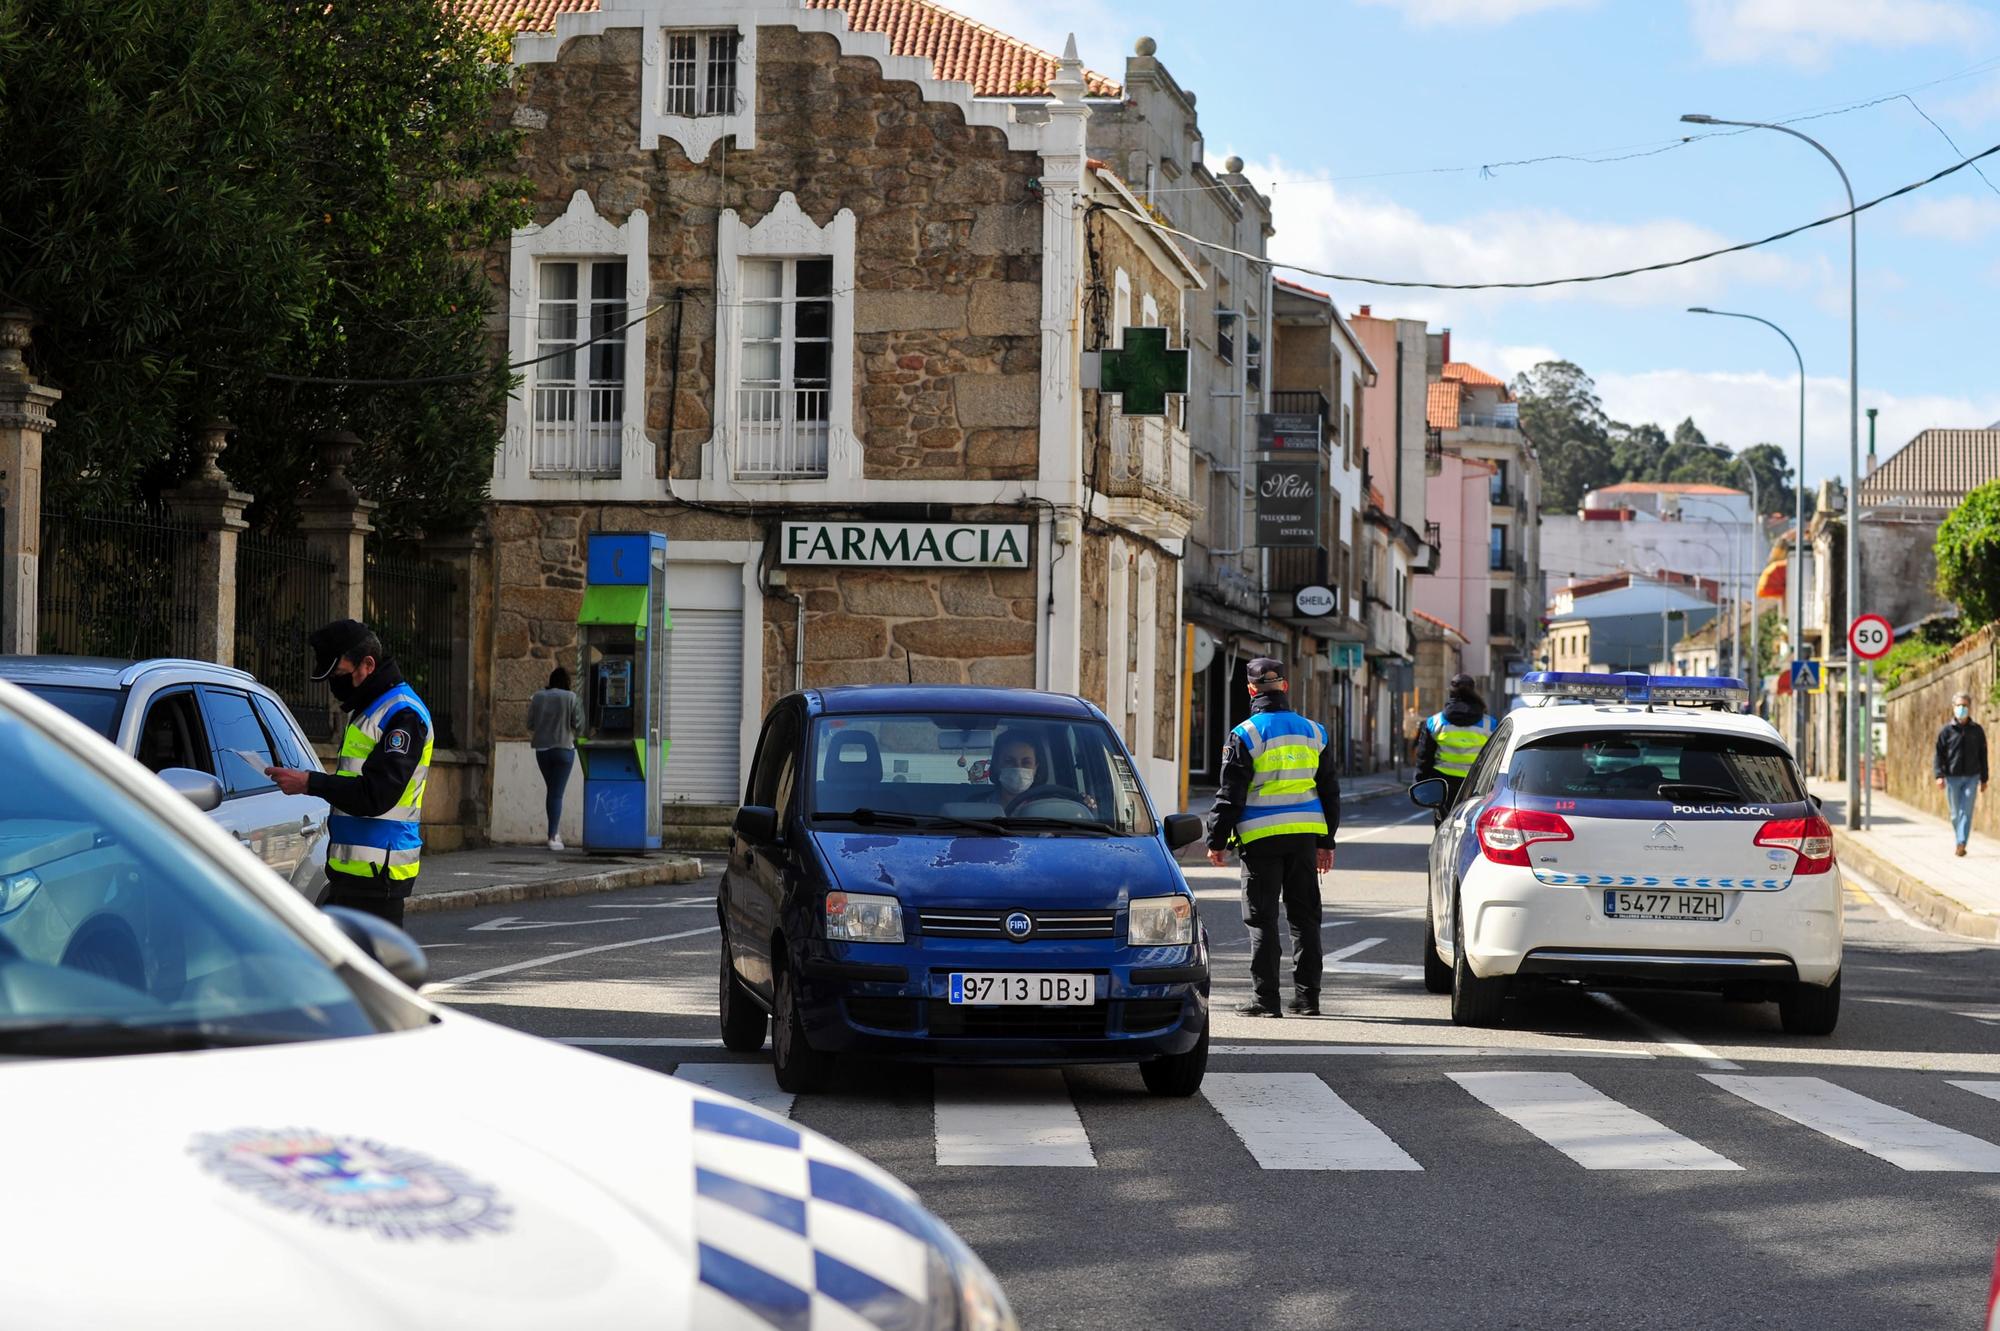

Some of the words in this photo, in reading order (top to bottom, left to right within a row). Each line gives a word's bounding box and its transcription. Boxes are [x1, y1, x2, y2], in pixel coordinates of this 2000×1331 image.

[788, 526, 1023, 563] FARMACIA
[1299, 596, 1332, 606] SHEILA
[1859, 630, 1883, 643] 50
[1555, 800, 1575, 809] 112
[1672, 805, 1725, 814] POLICÍA
[1733, 806, 1774, 816] LOCAL
[1620, 894, 1671, 912] 5477
[1679, 896, 1717, 914] HZH
[1010, 920, 1028, 930] FIAT
[964, 978, 1028, 1001] 9713
[1040, 978, 1087, 1001] DBJ
